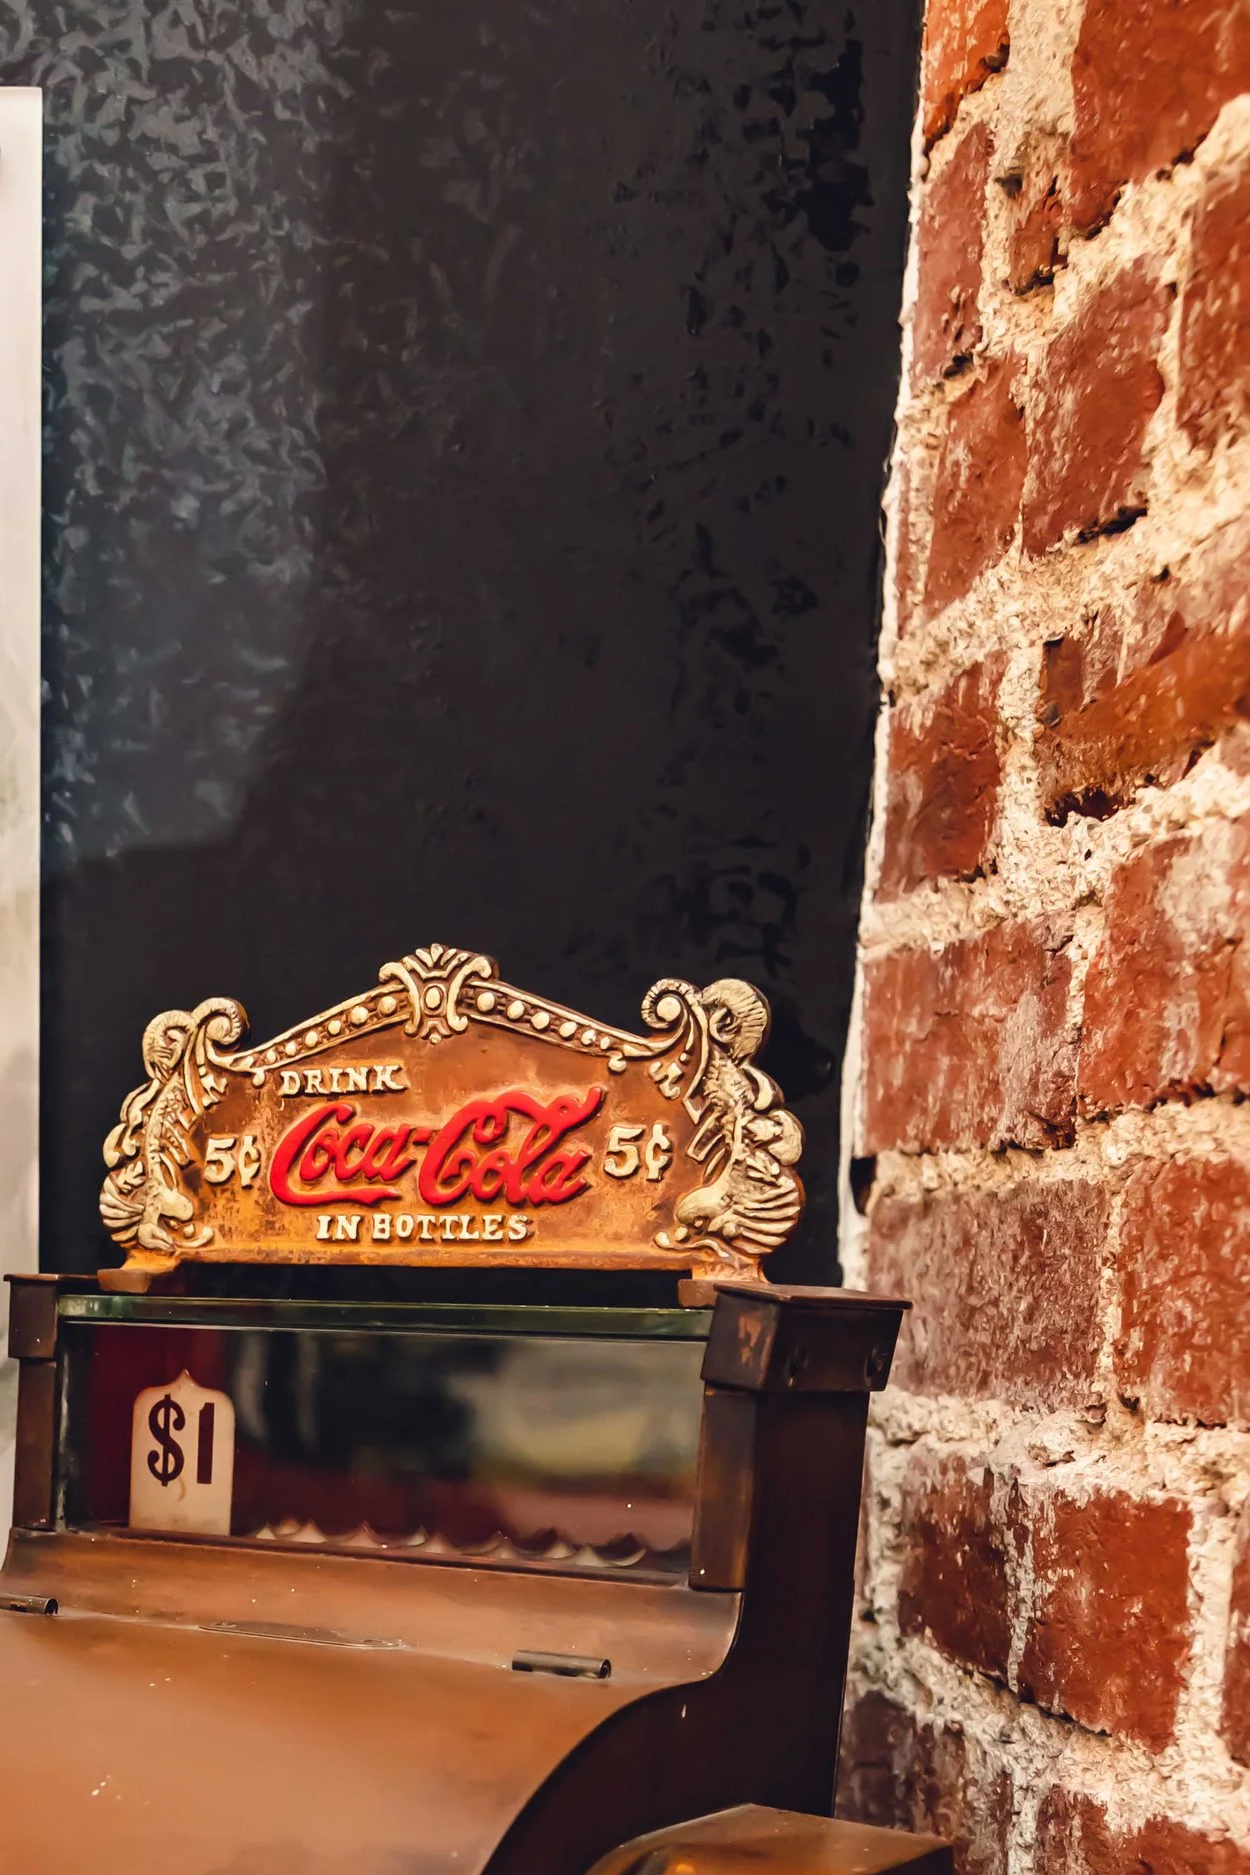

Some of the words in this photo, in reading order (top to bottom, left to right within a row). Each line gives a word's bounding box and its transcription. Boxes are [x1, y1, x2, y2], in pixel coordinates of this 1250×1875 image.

[279, 1066, 407, 1096] DRINK
[205, 1137, 260, 1186] 5¢
[270, 1087, 604, 1206] Coca-Cola
[605, 1124, 671, 1181] 5¢
[316, 1214, 361, 1241] IN
[372, 1214, 531, 1241] BOTTLES
[148, 1394, 214, 1486] $1
